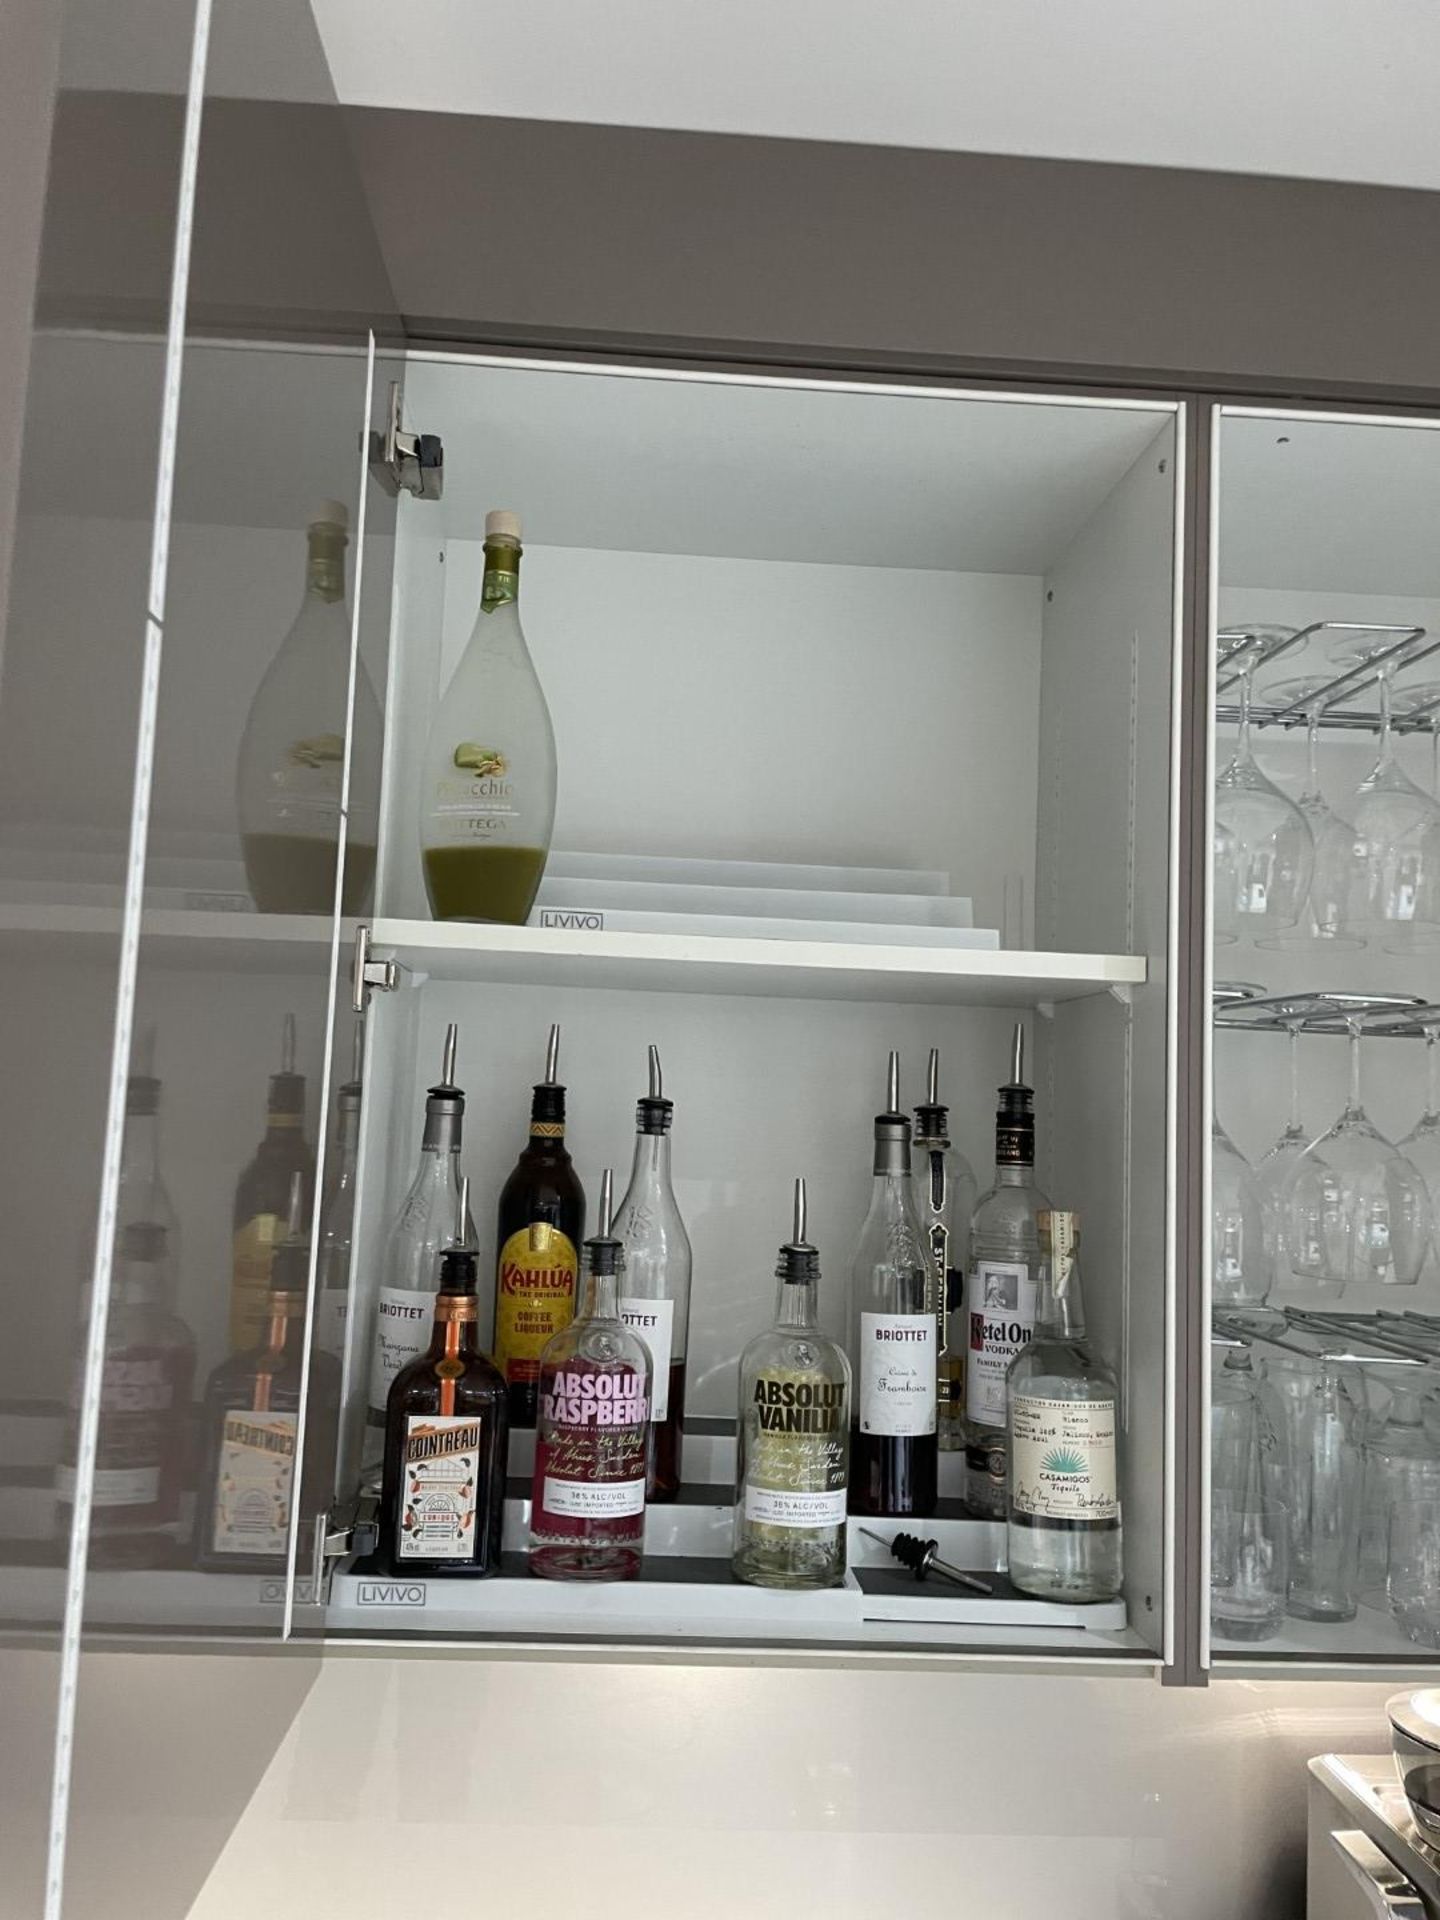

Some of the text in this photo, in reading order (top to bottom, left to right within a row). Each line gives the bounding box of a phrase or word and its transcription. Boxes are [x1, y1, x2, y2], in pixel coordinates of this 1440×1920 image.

[545, 914, 600, 929] LIVIVO
[501, 1263, 573, 1296] KAHLÚA
[517, 1311, 552, 1322] COFFEE
[514, 1322, 554, 1334] LIQUEUR
[1008, 1323, 1032, 1344] On
[876, 1329, 927, 1341] BRIOTTET
[553, 1371, 647, 1401] ABSOLUT
[754, 1379, 845, 1409] ABSOLUT
[407, 1426, 479, 1459] COINTREAU
[1039, 1472, 1090, 1483] CASAMIGOS
[1051, 1483, 1080, 1494] Tequila
[591, 1491, 627, 1501] ALC/VOL
[793, 1501, 829, 1510] ALC/VOL
[362, 1586, 422, 1602] LIVIVO
